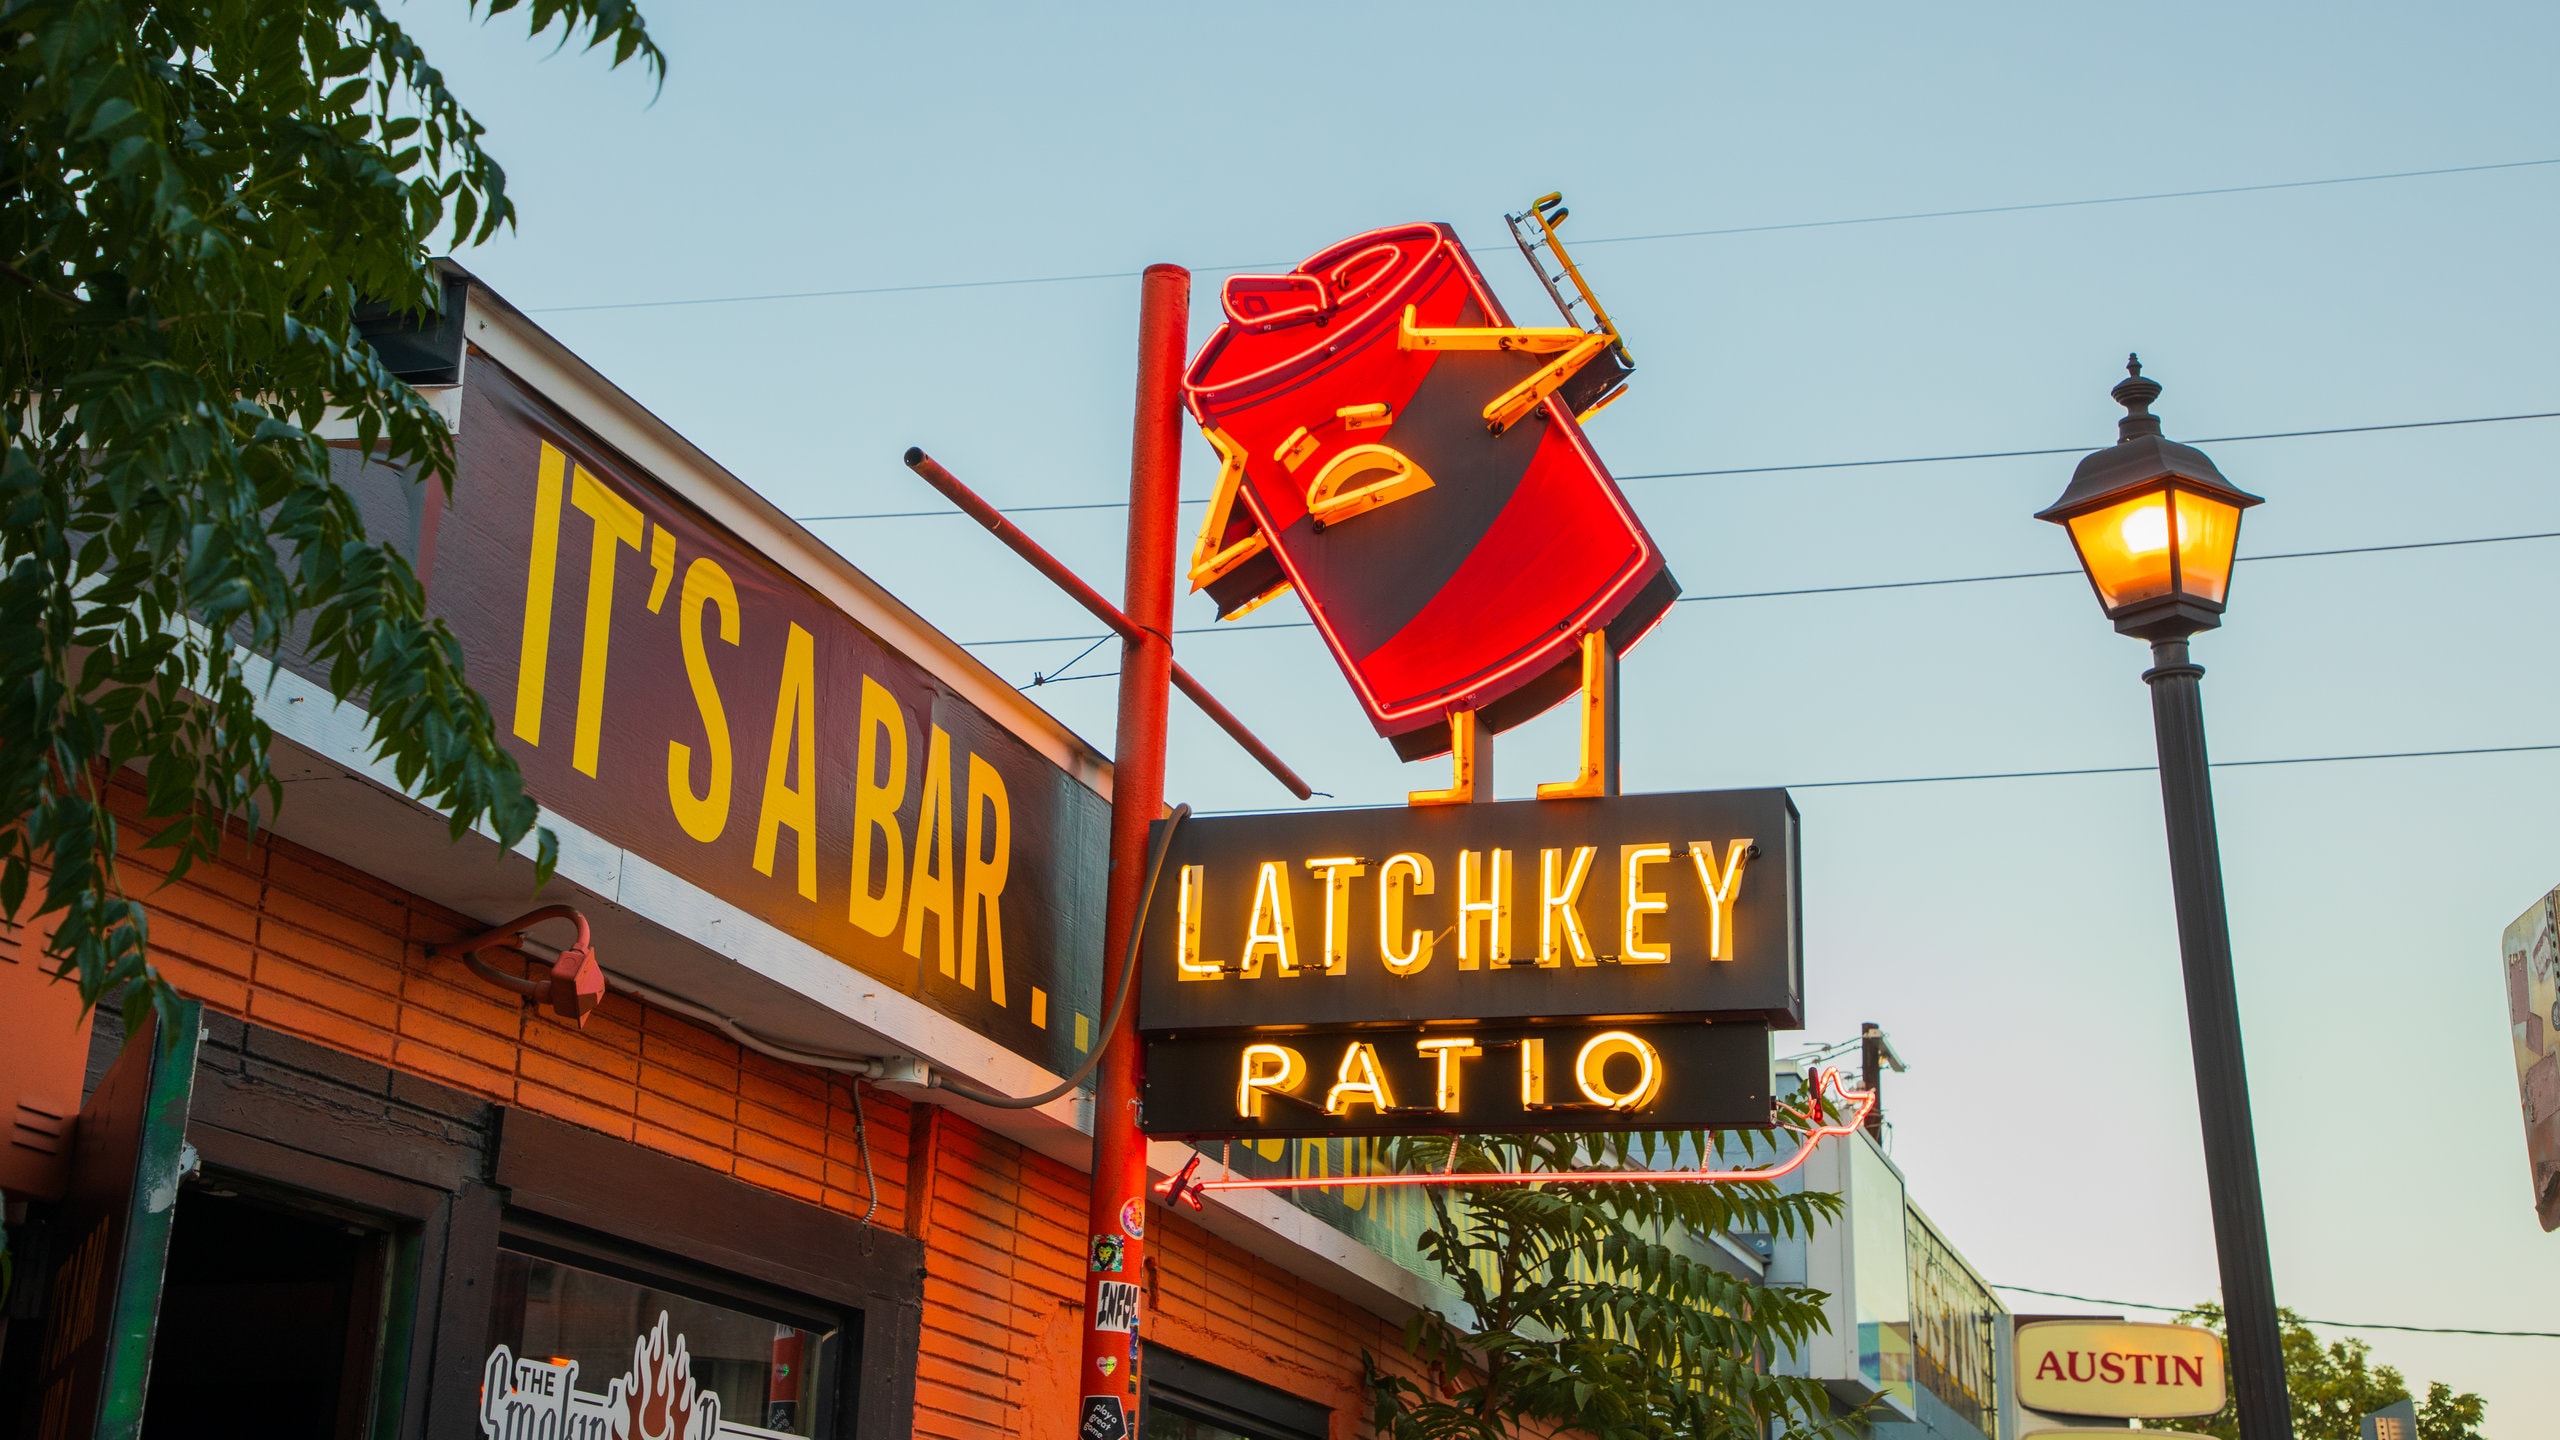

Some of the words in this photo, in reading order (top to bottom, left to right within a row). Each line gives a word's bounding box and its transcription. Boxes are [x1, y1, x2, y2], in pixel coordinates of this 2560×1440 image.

[513, 439, 740, 843] IT'S
[752, 621, 817, 903] A
[1177, 838, 1755, 982] LATCHKEY
[1237, 1031, 1662, 1118] PATIO
[520, 1365, 556, 1398] THE
[2035, 1350, 2204, 1388] AUSTIN
[1089, 1414, 1112, 1430] great
[1093, 1404, 1112, 1420] play
